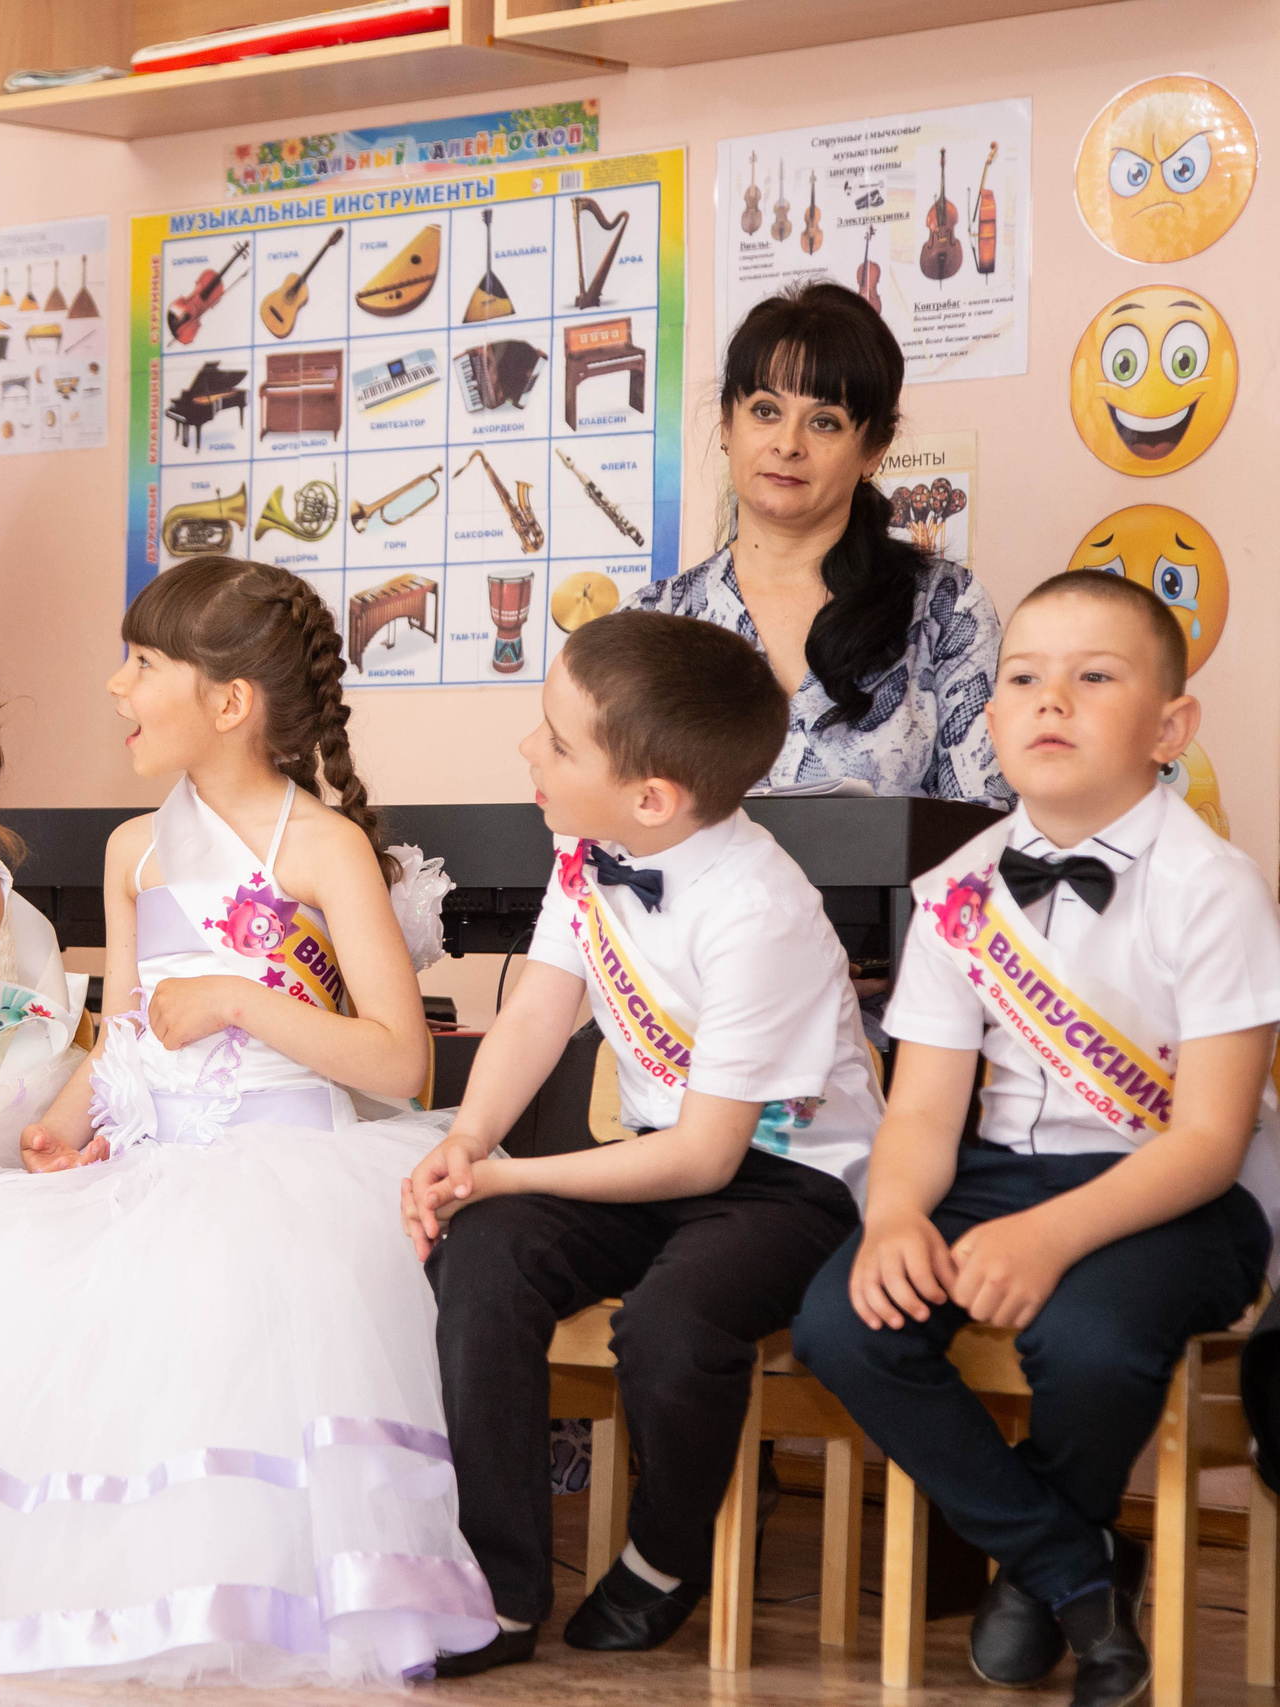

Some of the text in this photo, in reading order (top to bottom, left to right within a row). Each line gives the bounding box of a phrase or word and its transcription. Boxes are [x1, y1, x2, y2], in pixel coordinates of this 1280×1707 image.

[811, 133, 862, 148] Струнные
[242, 123, 583, 184] МУЗЫКАЛЬНЫЙ КАЛЕЙДОСКОП
[170, 178, 496, 235] МУЗЫКАЛЬНЫЕ ИНСТРУМЕНТЫ
[837, 211, 910, 226] Электроскрипка
[267, 251, 299, 261] ГИТАРА
[494, 246, 548, 260] БАЛАЛАЙКА
[618, 255, 643, 266] АРФА
[149, 255, 161, 345] СТРУННЫЕ
[914, 299, 961, 312] Контрабас
[148, 358, 161, 464] КЛАВИШНЫЕ
[370, 418, 426, 430] СИНТЕЗАТОР
[578, 415, 627, 427] КЛАВЕСИН
[472, 422, 525, 434] АККОРДЕОН
[601, 460, 638, 471] ФЛЕЙТА
[880, 452, 946, 474] ументы
[191, 480, 210, 489] ТУБА
[147, 483, 159, 563] ДУХОВЫЕ
[454, 529, 504, 540] САКСОФОН
[384, 541, 407, 550] ГОРН
[275, 554, 319, 565] ВАЛТОРНА
[605, 564, 647, 574] ТАРЕЛКИ
[450, 631, 489, 641] ТАМ-ТАМ
[368, 668, 415, 678] ВИБРОФОН
[582, 940, 678, 1087] детского сада
[987, 931, 1173, 1124] ВЫПУСКНИК
[989, 983, 1124, 1125] детского сада
